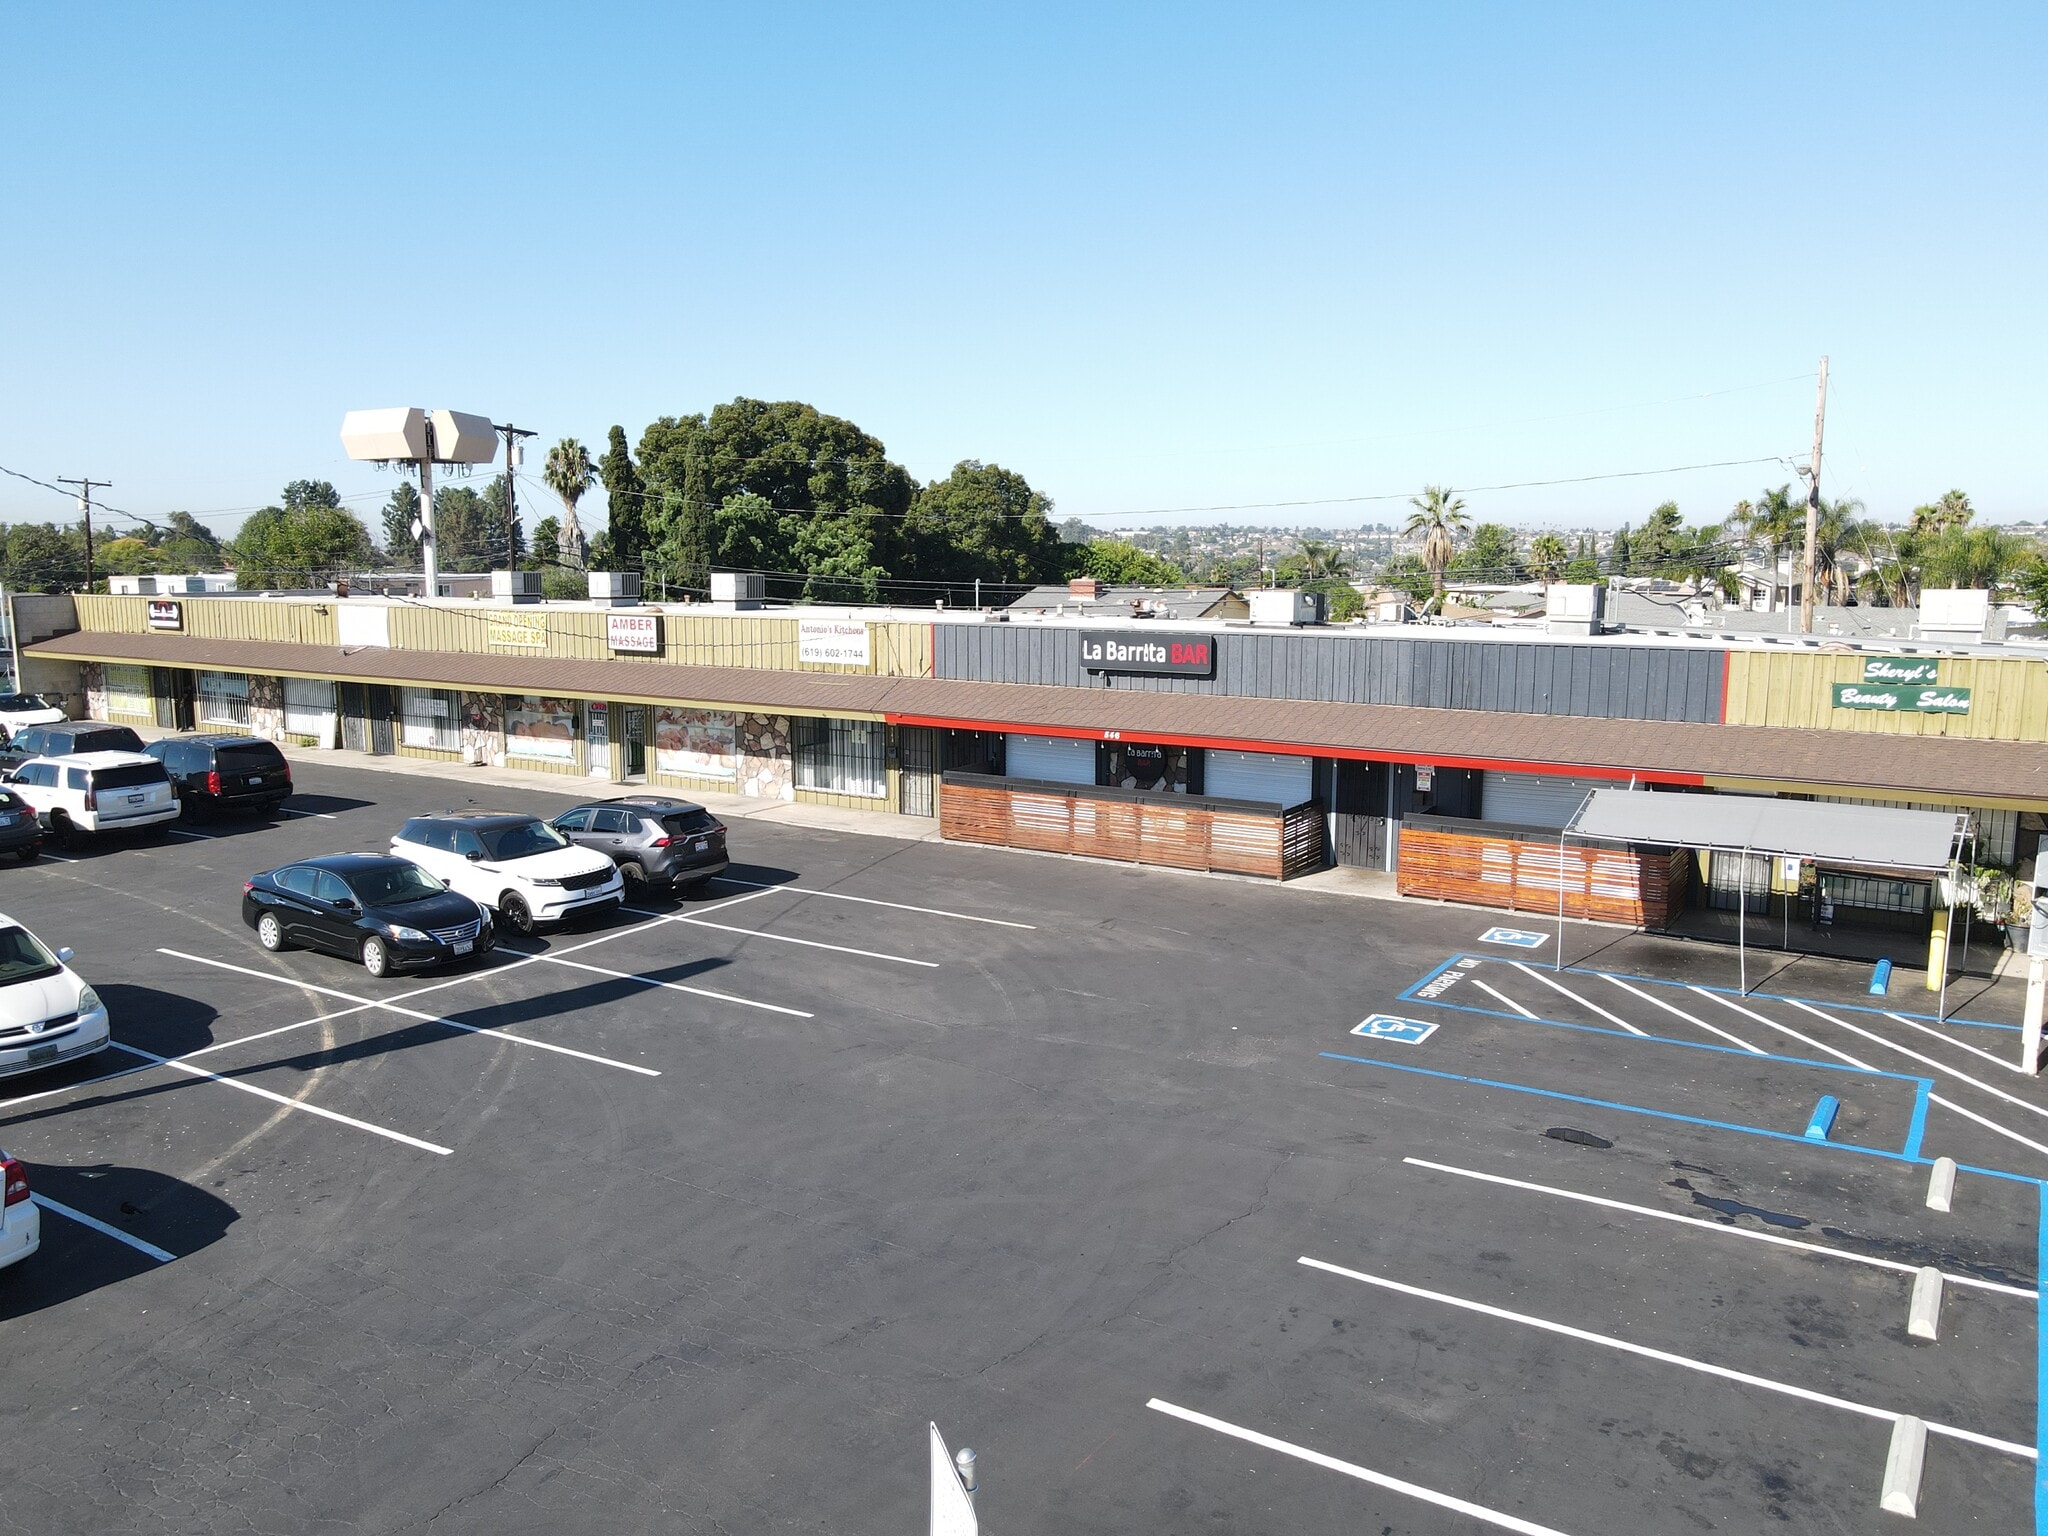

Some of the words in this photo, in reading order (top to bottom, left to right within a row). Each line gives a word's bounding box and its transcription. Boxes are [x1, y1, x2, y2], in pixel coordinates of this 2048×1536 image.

[489, 614, 512, 627] GRAND
[514, 614, 546, 629] OPENING
[612, 618, 653, 631] AMBER
[490, 629, 528, 644] MASSAGE
[531, 631, 546, 644] SPA
[610, 635, 655, 648] MASSAGE
[801, 647, 823, 659] (619)
[825, 648, 864, 659] 602-1744
[1083, 640, 1102, 660] La
[1106, 641, 1167, 663] Barrita
[1171, 643, 1208, 665] BAR
[1864, 662, 1938, 682] Sheryl's
[1840, 688, 1898, 708] Beauty
[1916, 691, 1970, 708] Salon
[1456, 958, 1482, 969] NO
[1417, 970, 1466, 998] PARKING
